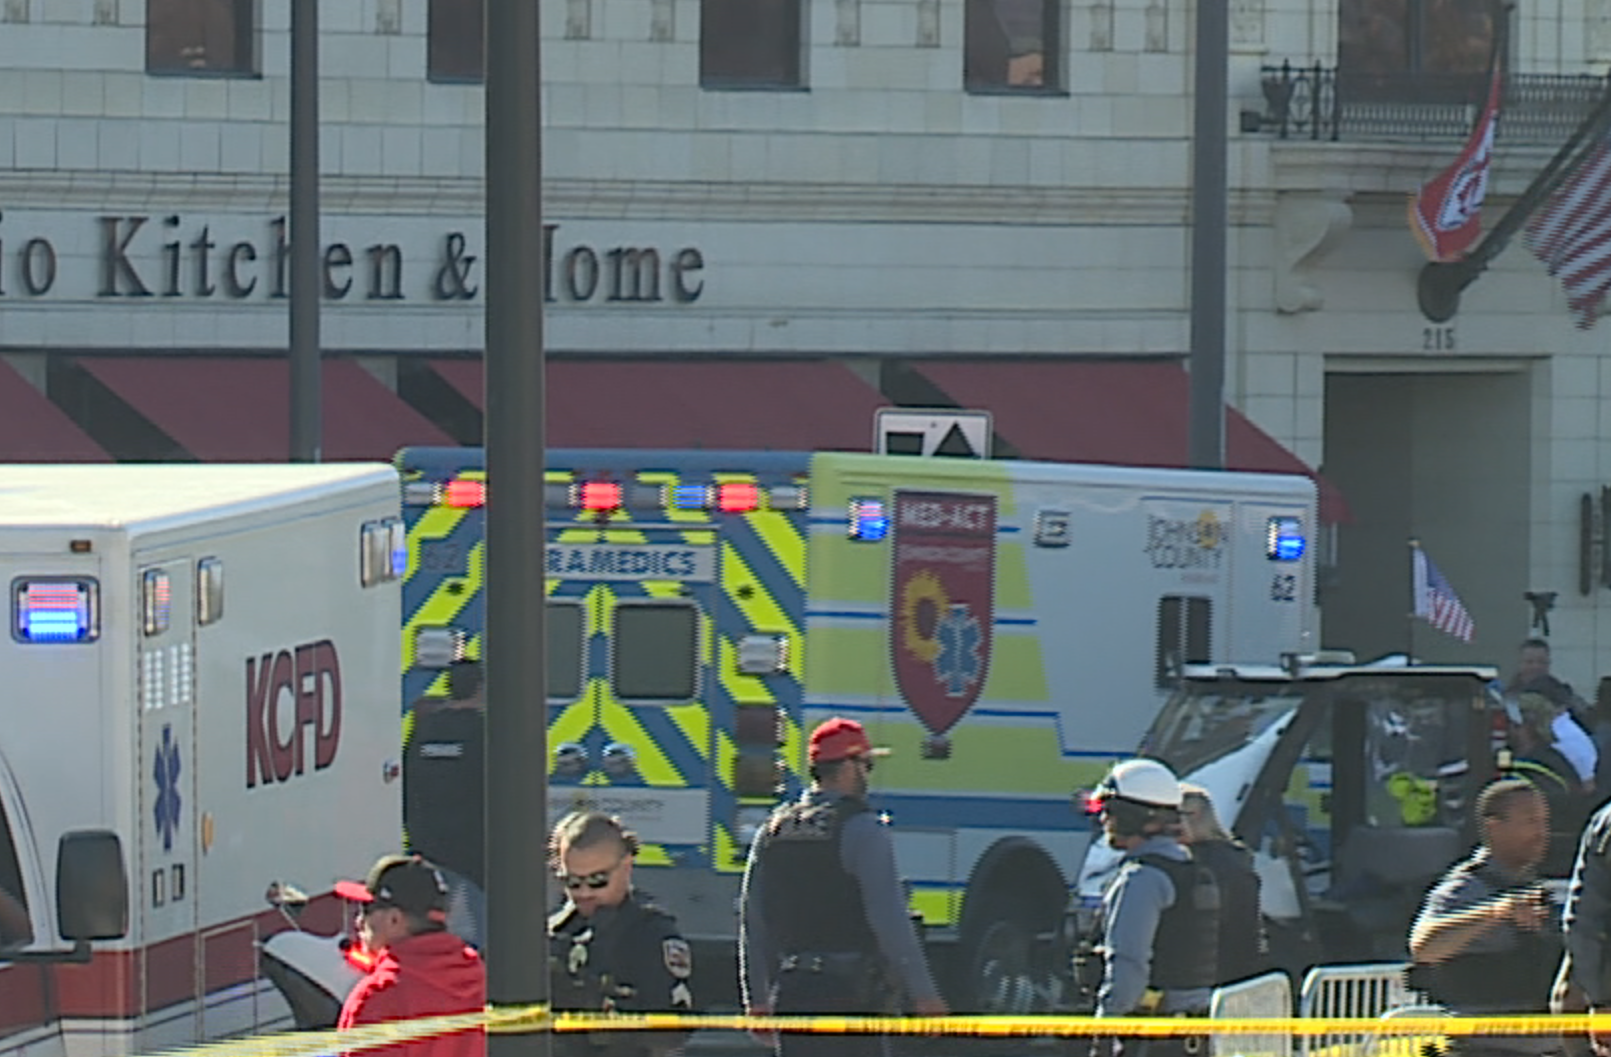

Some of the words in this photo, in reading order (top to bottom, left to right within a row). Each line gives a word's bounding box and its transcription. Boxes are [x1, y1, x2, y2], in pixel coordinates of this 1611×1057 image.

[433, 231, 479, 301] &
[1422, 327, 1455, 350] 215
[901, 501, 989, 529] MED-ACT
[547, 550, 697, 575] RAMEDICS
[1271, 574, 1296, 602] 62
[246, 639, 341, 789] KCFD
